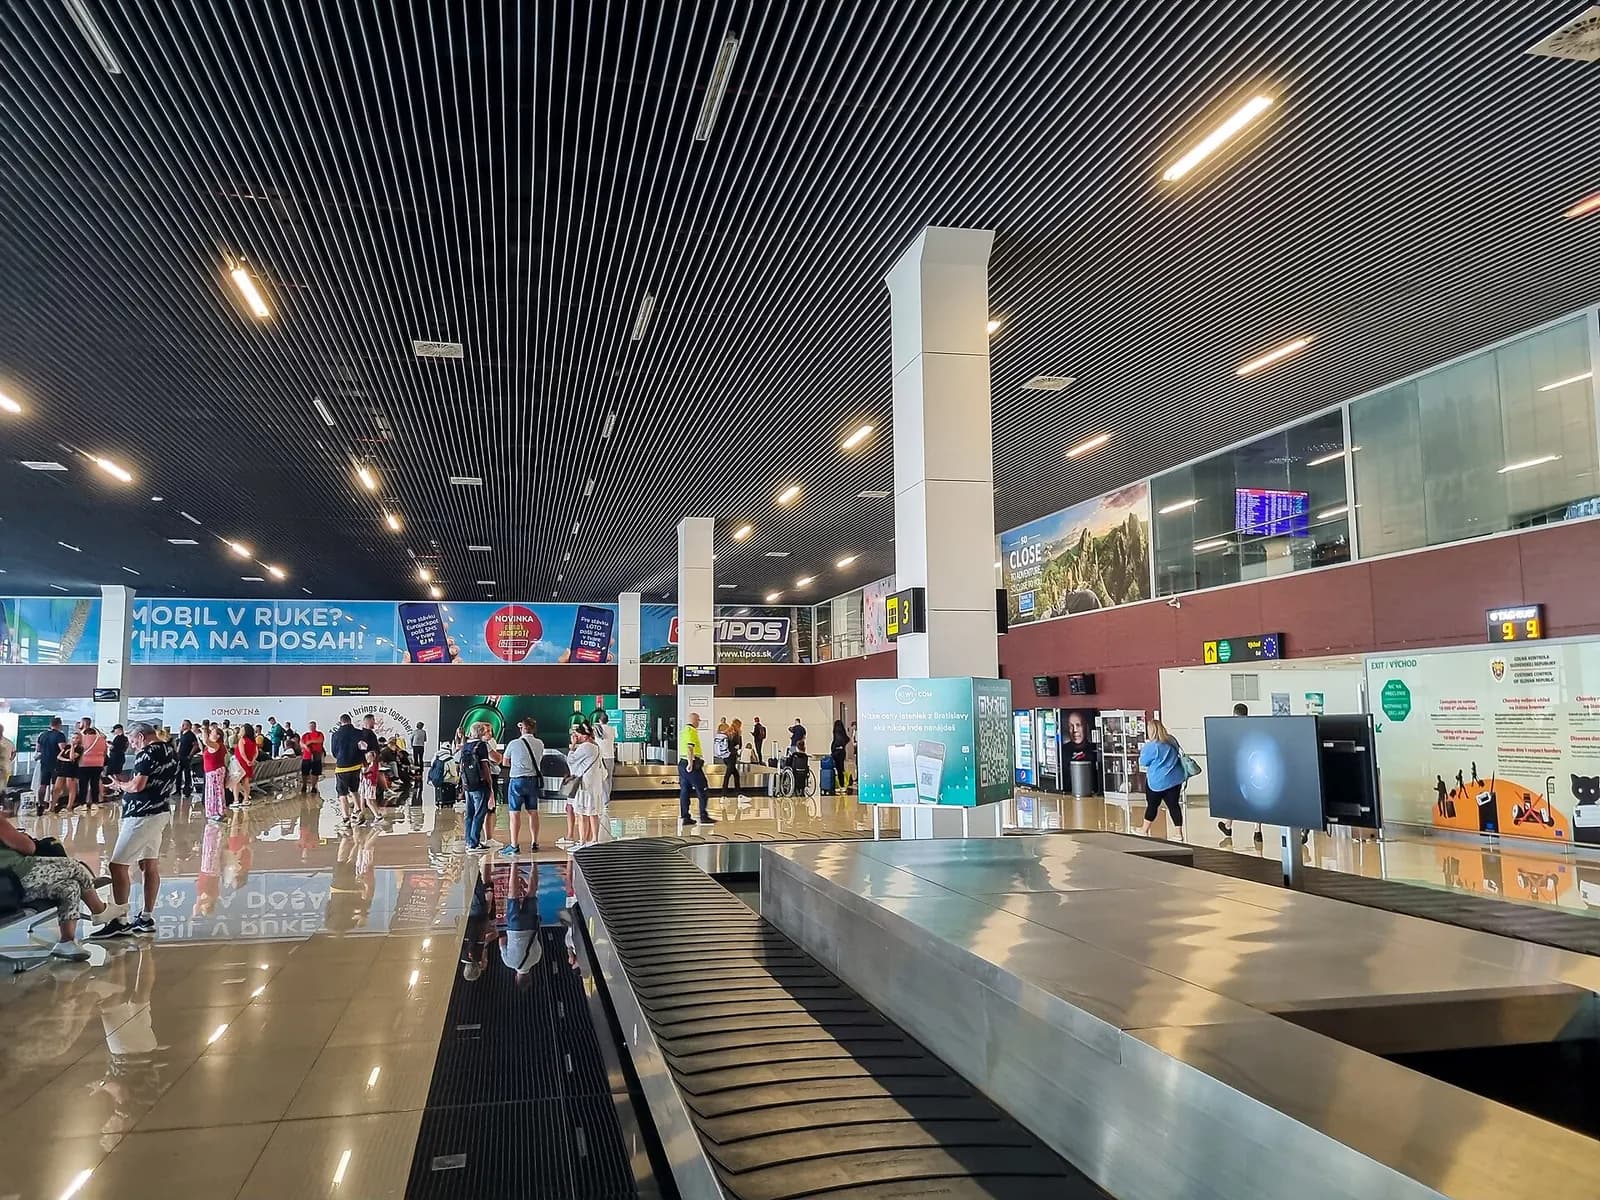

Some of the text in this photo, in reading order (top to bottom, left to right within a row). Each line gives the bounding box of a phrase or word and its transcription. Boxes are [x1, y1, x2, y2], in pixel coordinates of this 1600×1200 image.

[1010, 543, 1041, 569] CLOSE
[133, 606, 343, 626] MOBIL V RUKE?
[495, 615, 534, 623] NOVINKA
[903, 600, 909, 624] 3
[1503, 619, 1538, 640] 9 9
[209, 630, 249, 649] NA
[259, 631, 363, 650] DOSAH!
[717, 650, 772, 660] www.tipos.sk
[1371, 661, 1384, 669] EXIT
[353, 705, 377, 716] brings
